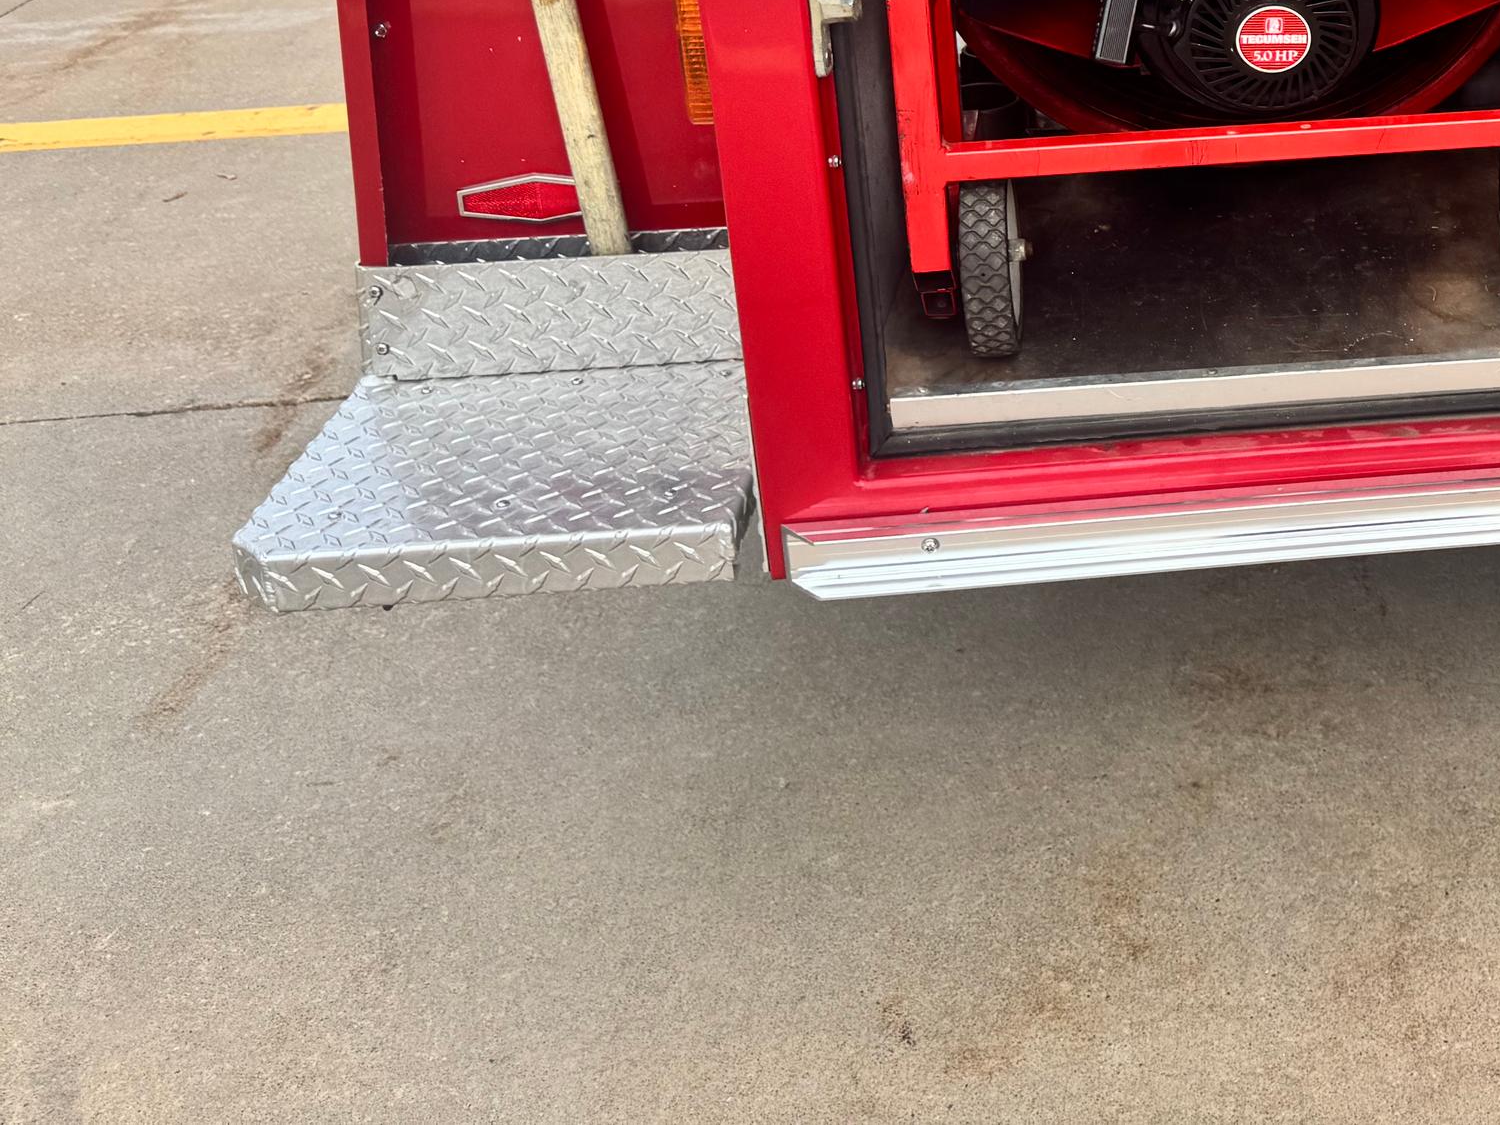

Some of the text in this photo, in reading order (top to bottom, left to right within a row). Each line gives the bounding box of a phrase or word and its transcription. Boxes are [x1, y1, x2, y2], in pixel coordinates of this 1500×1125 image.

[1241, 34, 1308, 45] TECUMSEH
[1253, 50, 1298, 62] 5.0 HP
